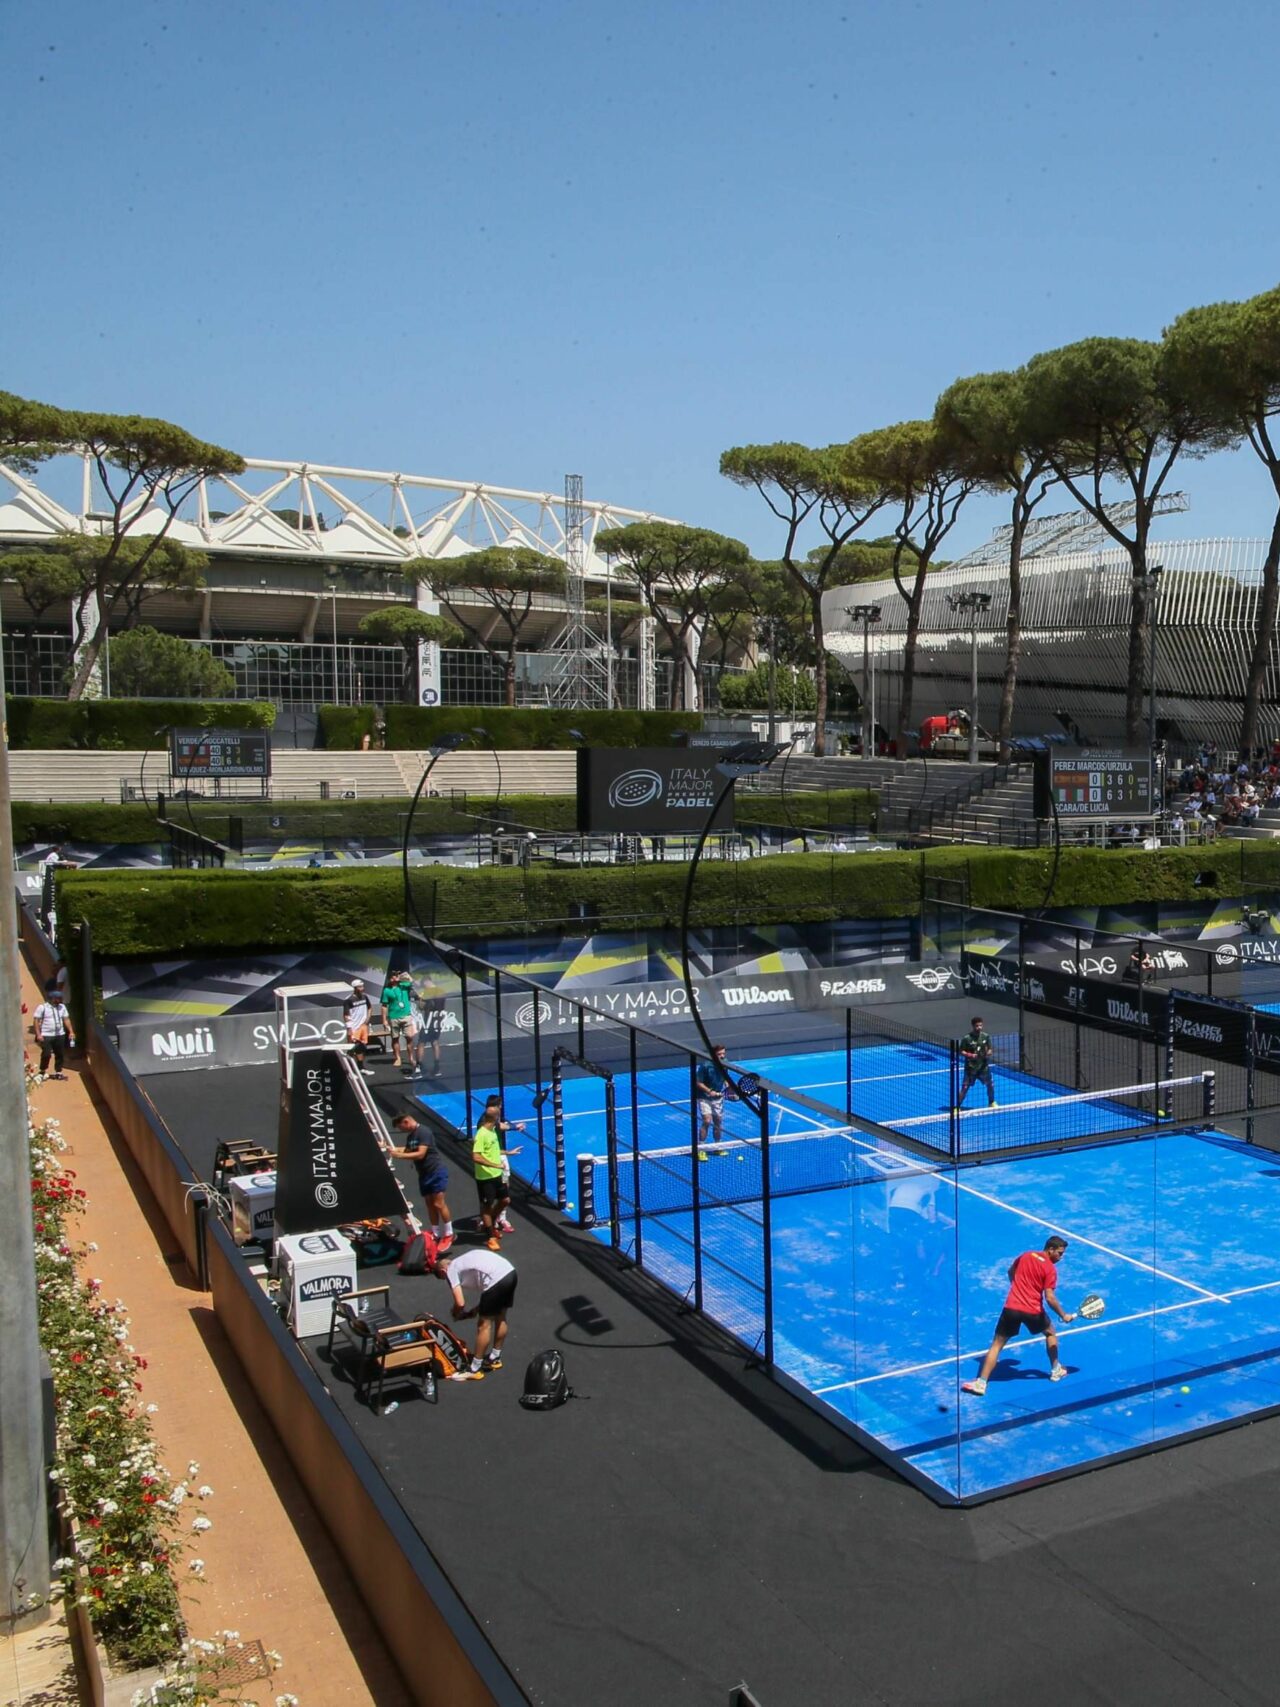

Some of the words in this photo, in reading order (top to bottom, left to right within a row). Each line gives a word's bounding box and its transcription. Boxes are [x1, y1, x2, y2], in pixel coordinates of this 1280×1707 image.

[670, 768, 711, 780] ITALY
[1054, 761, 1075, 770] PEREZ
[668, 781, 712, 790] MAJOR
[1107, 774, 1113, 785] 3
[1117, 774, 1123, 785] 6
[1128, 774, 1134, 785] 0
[666, 798, 714, 808] PADEL
[1107, 790, 1113, 800] 6
[1117, 790, 1123, 801] 3
[1090, 803, 1110, 812] LUCIA
[1240, 940, 1277, 955] ITALY
[1060, 956, 1117, 977] SWAG
[722, 986, 793, 1006] Wilson
[152, 1027, 214, 1056] Nuii
[253, 1020, 347, 1050] SWAG
[307, 1069, 325, 1128] MAJOR
[324, 1068, 333, 1111] PADEL
[311, 1132, 329, 1178] ITALY
[327, 1118, 338, 1178] PREMIER
[302, 1277, 350, 1295] VALMORA
